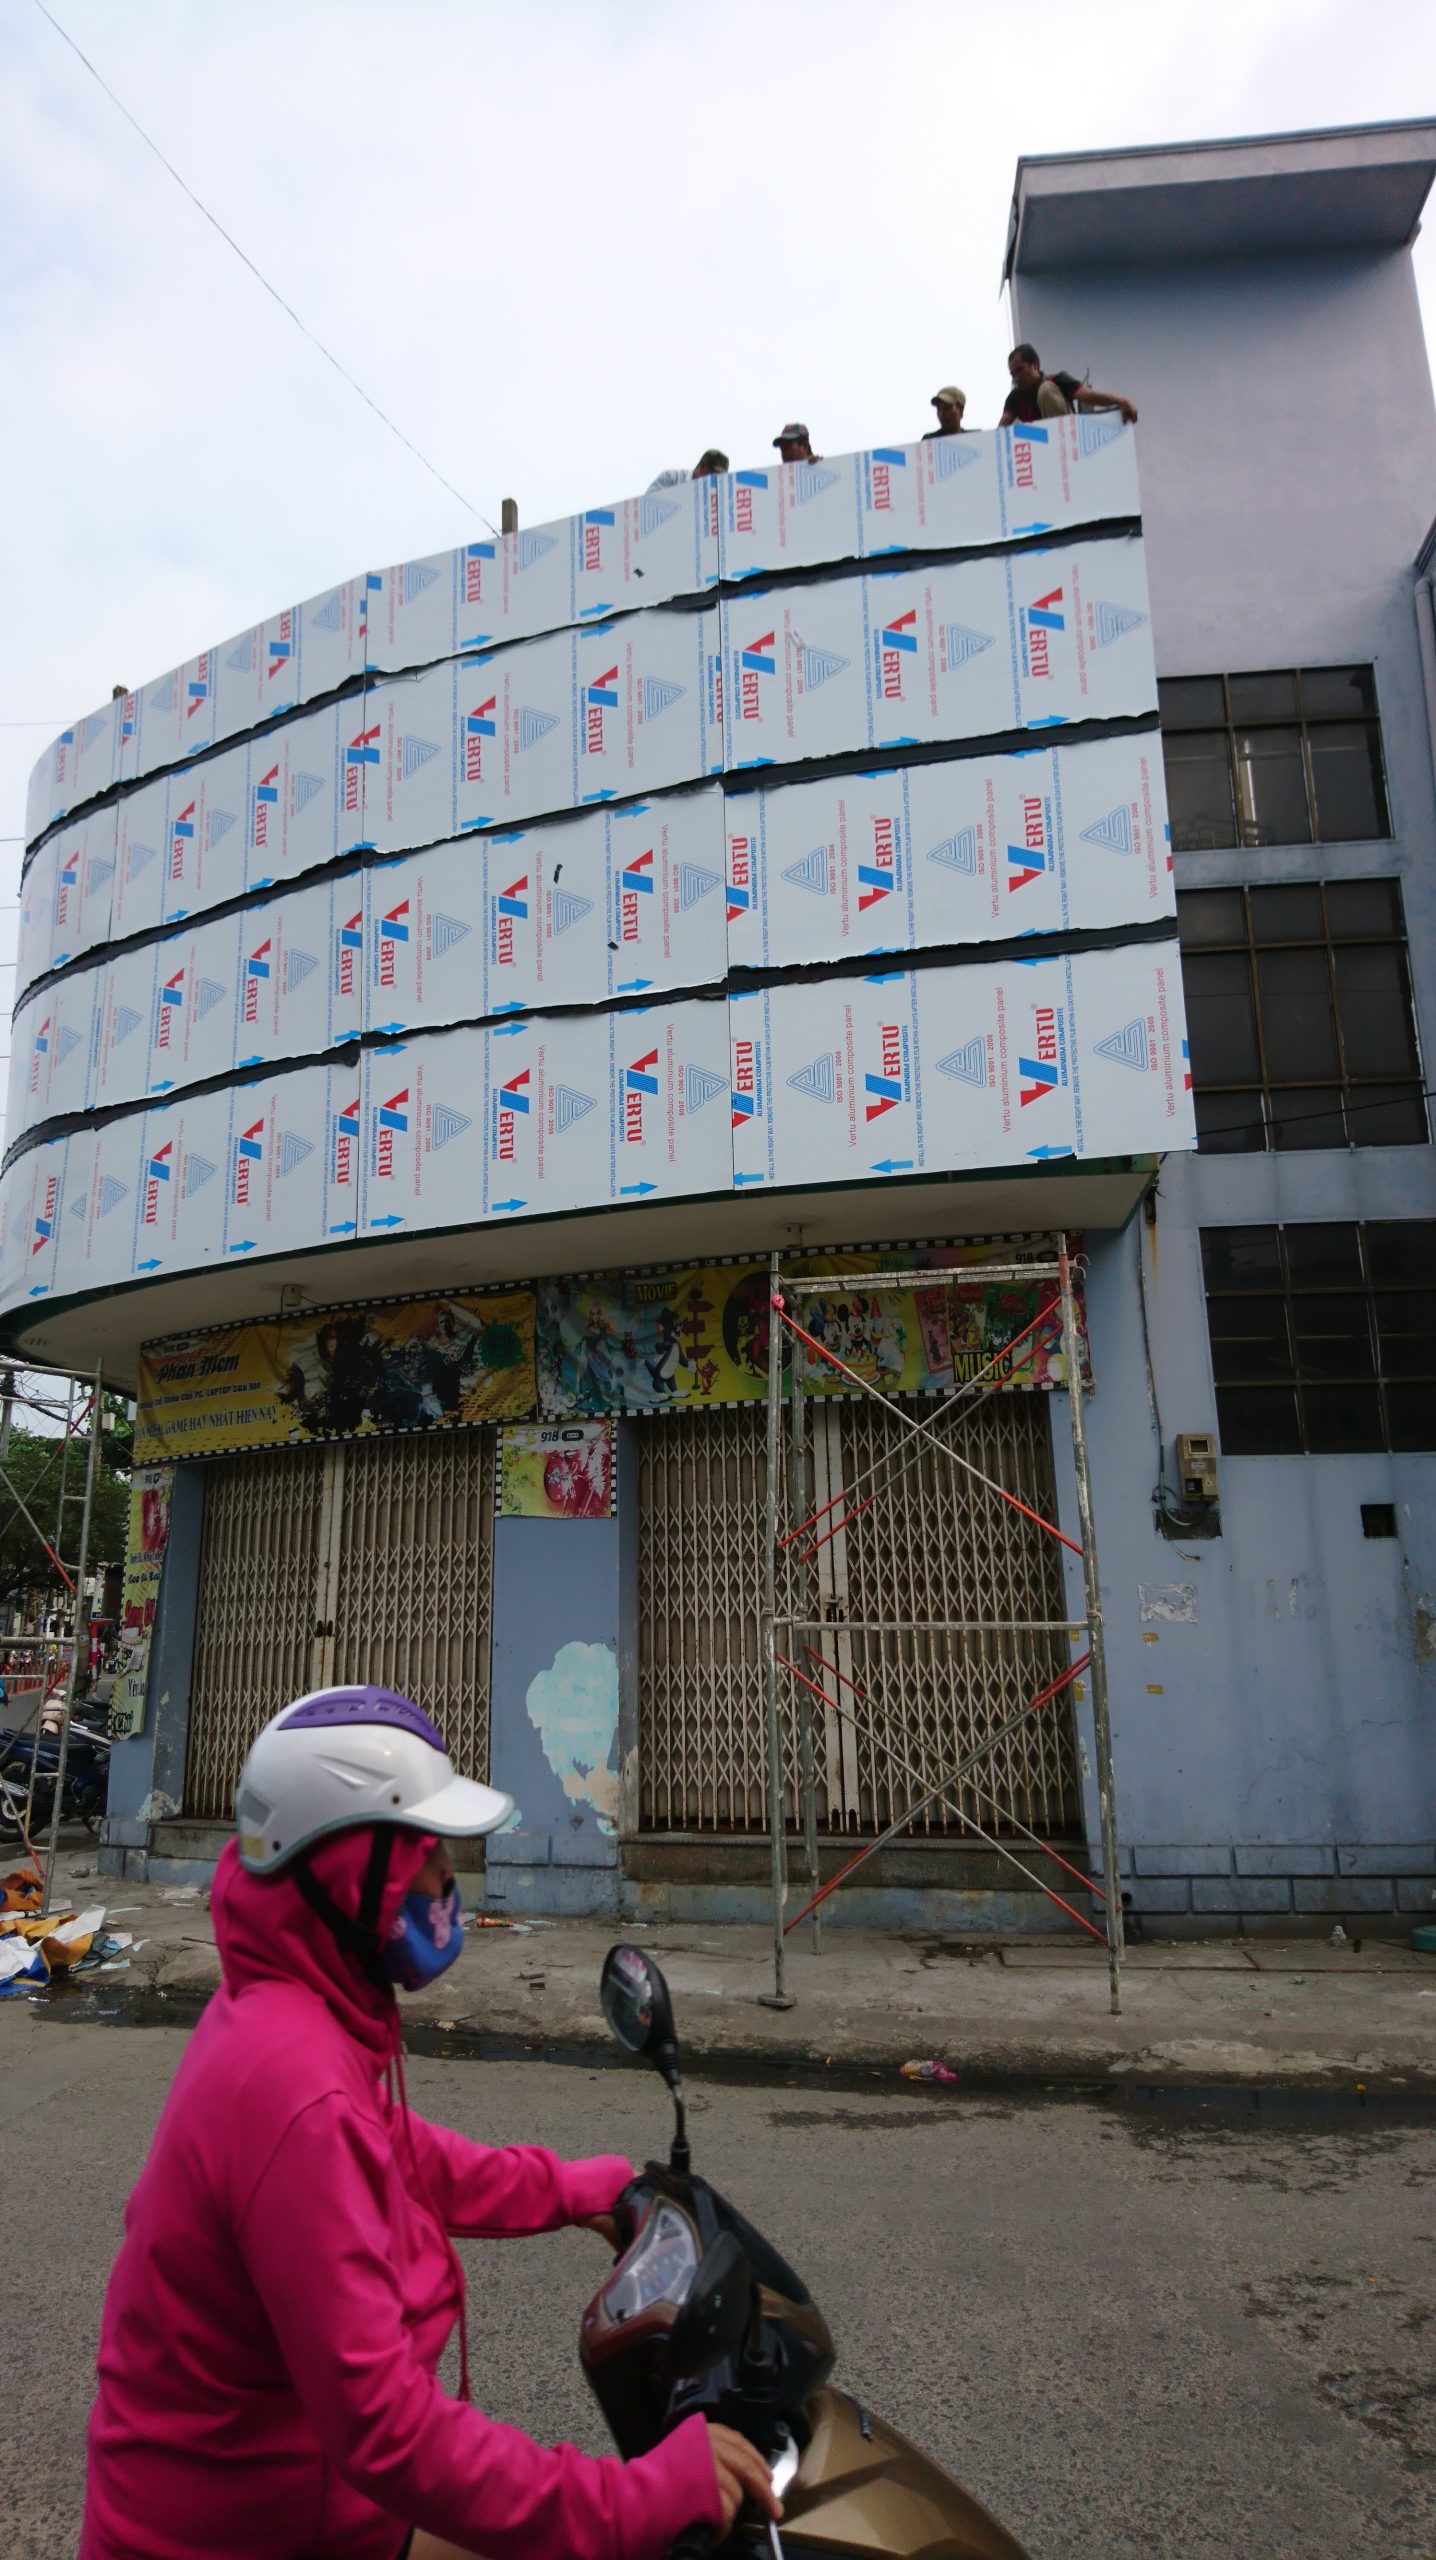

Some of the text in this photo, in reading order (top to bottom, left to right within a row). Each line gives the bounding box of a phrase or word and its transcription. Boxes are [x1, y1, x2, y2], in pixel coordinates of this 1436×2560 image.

[844, 1005, 856, 1147] Vertu aluminium composite panel
[996, 987, 1011, 1132] Vertu aluminium composite panel
[1155, 966, 1175, 1117] Vertu aluminium composite panel
[666, 1023, 675, 1162] Vertu aluminium composite panel
[635, 1282, 677, 1303] MOVIE
[1015, 1252, 1035, 1265] 918
[952, 1349, 1013, 1385] MUSIC
[541, 1431, 559, 1442] 918
